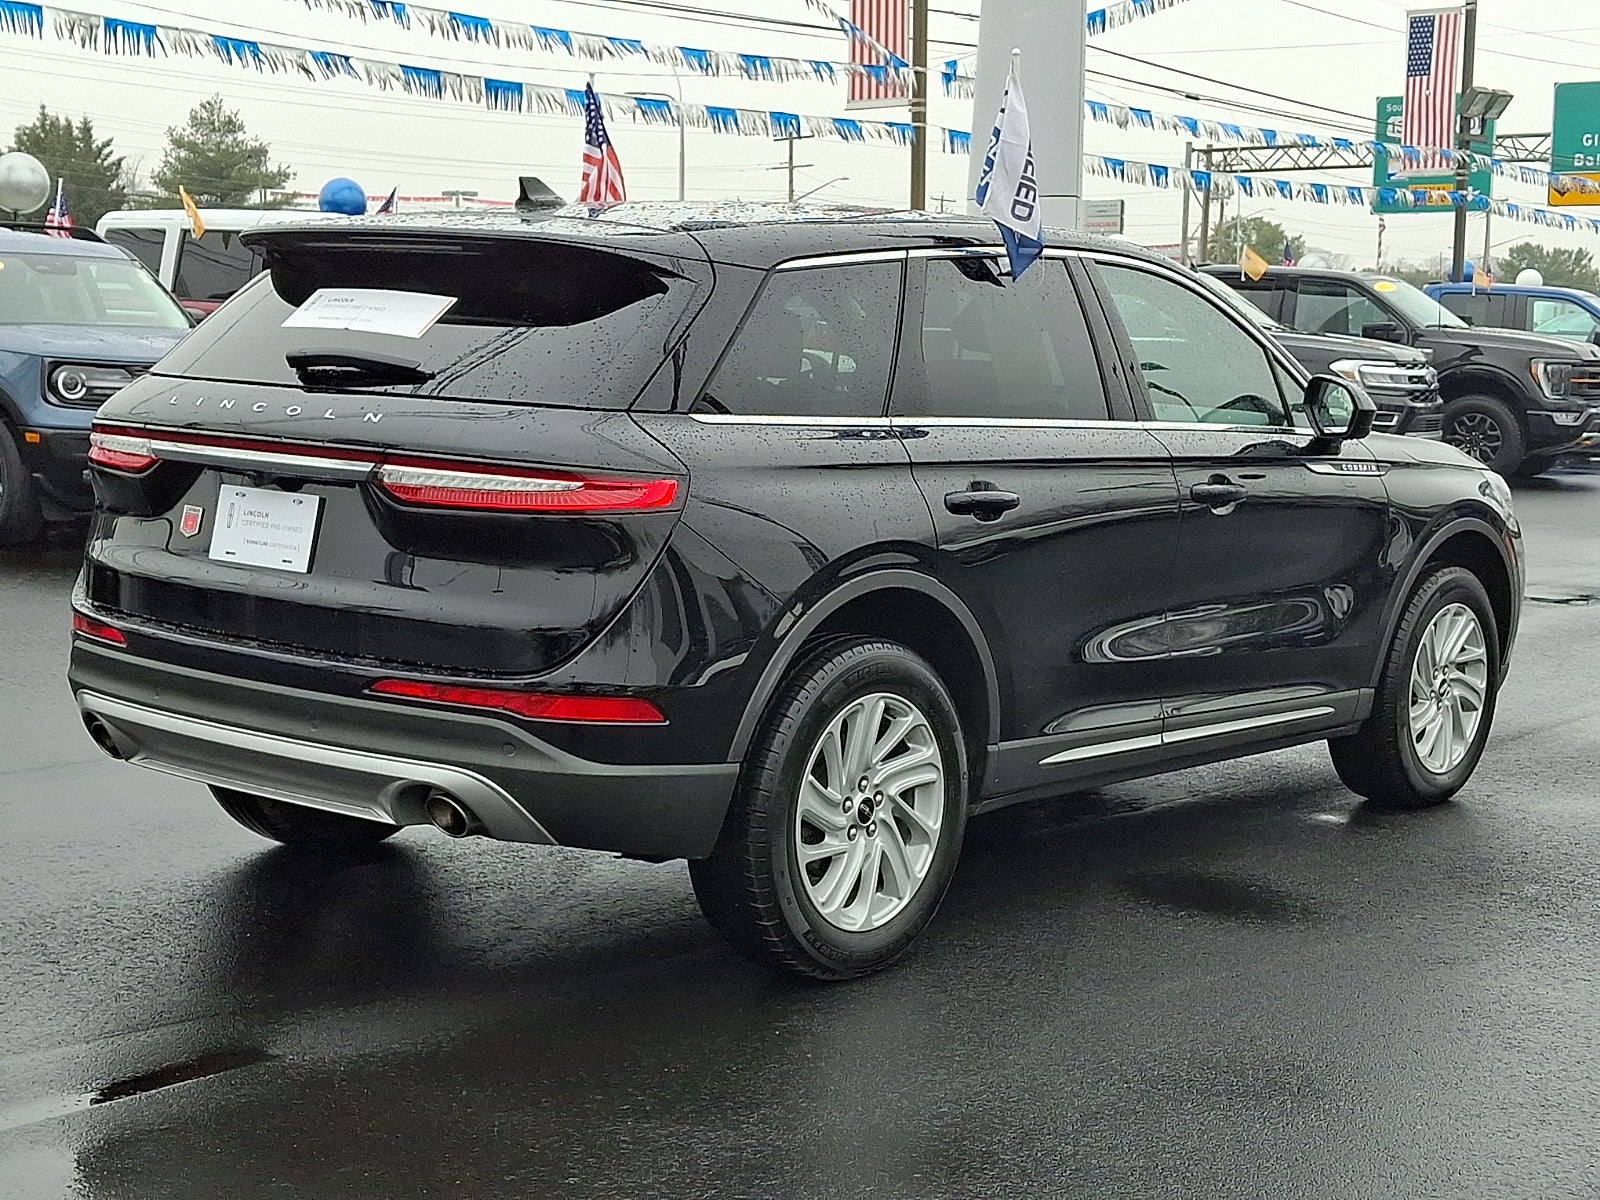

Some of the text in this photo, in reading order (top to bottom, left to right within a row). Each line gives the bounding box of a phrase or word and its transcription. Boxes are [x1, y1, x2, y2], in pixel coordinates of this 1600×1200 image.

[1386, 103, 1403, 112] Sou
[169, 395, 383, 423] LINCOLN
[243, 509, 270, 519] LINCOLN
